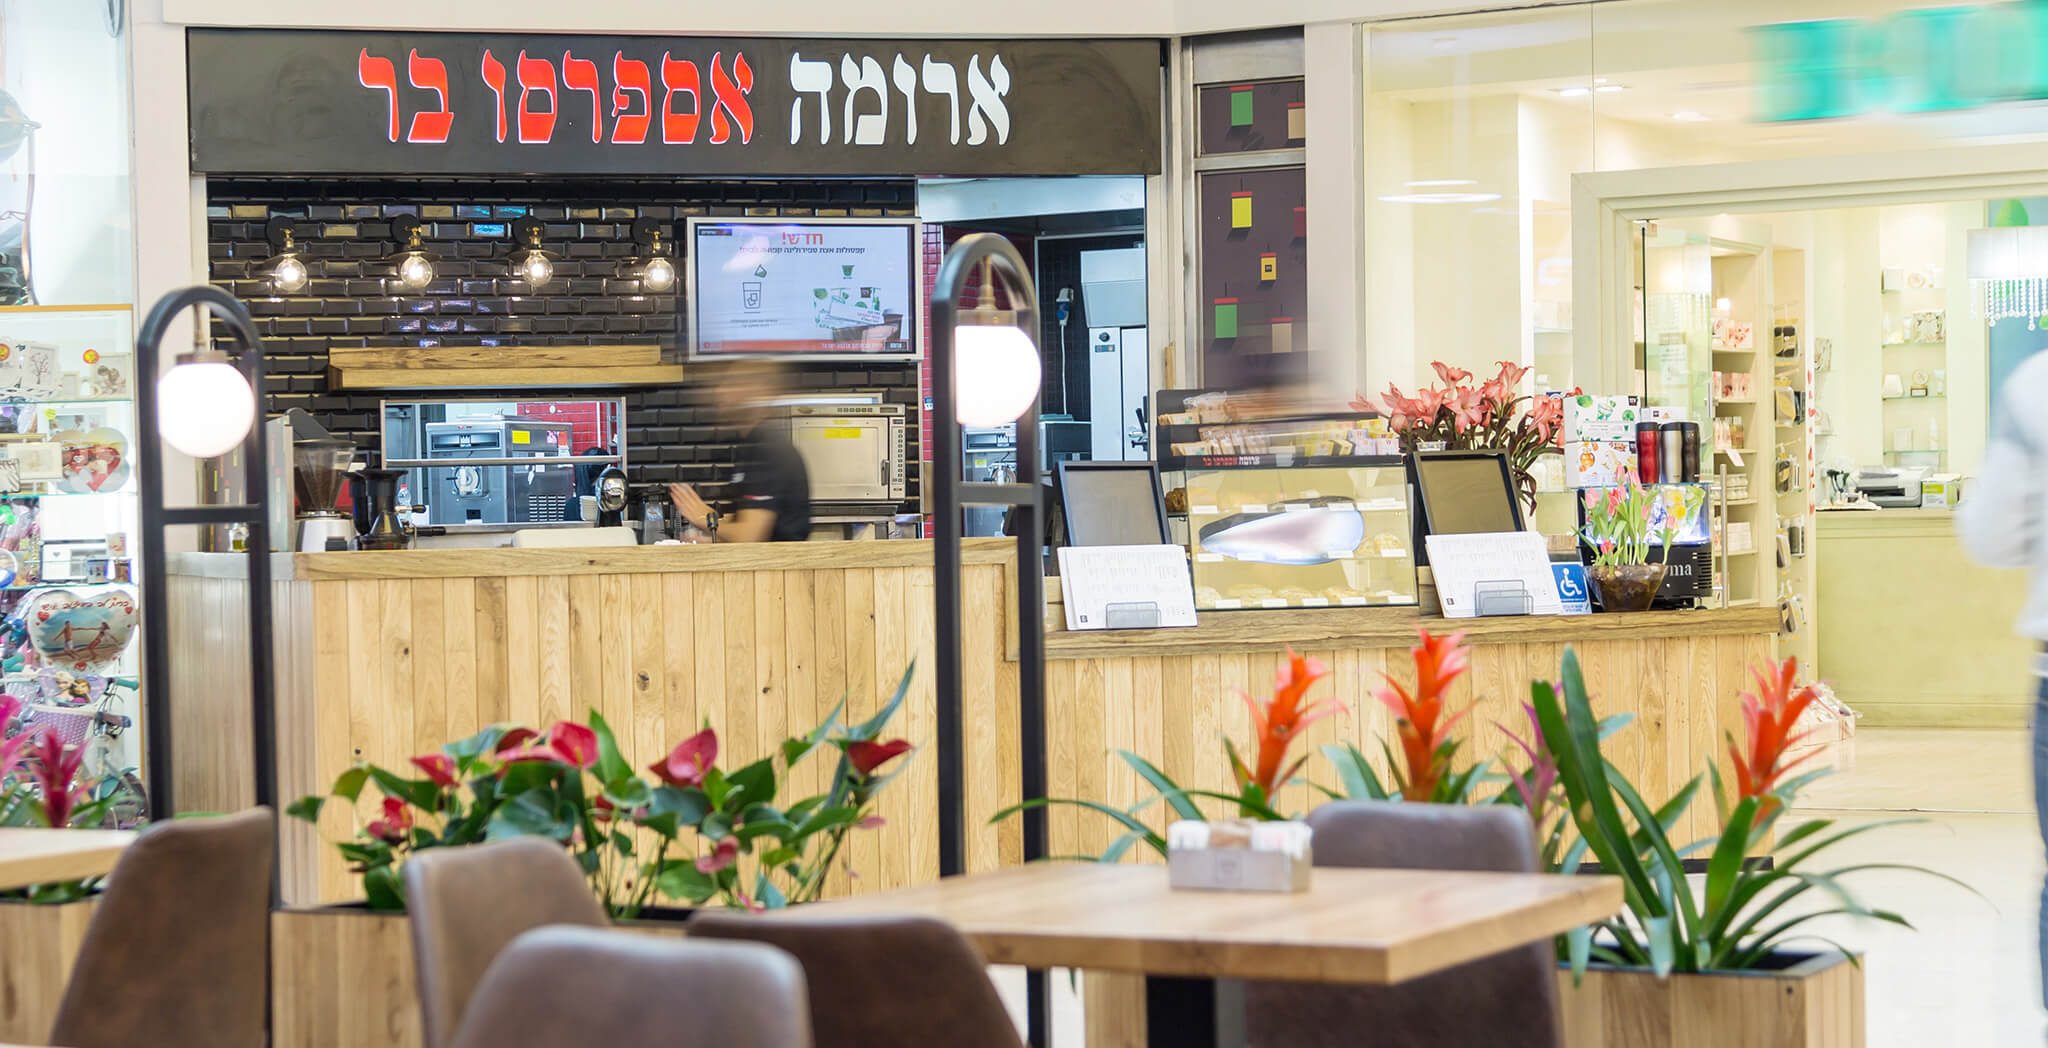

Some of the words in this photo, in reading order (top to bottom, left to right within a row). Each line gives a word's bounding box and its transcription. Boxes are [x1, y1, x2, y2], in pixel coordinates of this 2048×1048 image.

[358, 47, 455, 144] בר
[481, 48, 755, 145] אספרסו
[790, 52, 1011, 146] ארומה
[782, 232, 824, 245] חדש!
